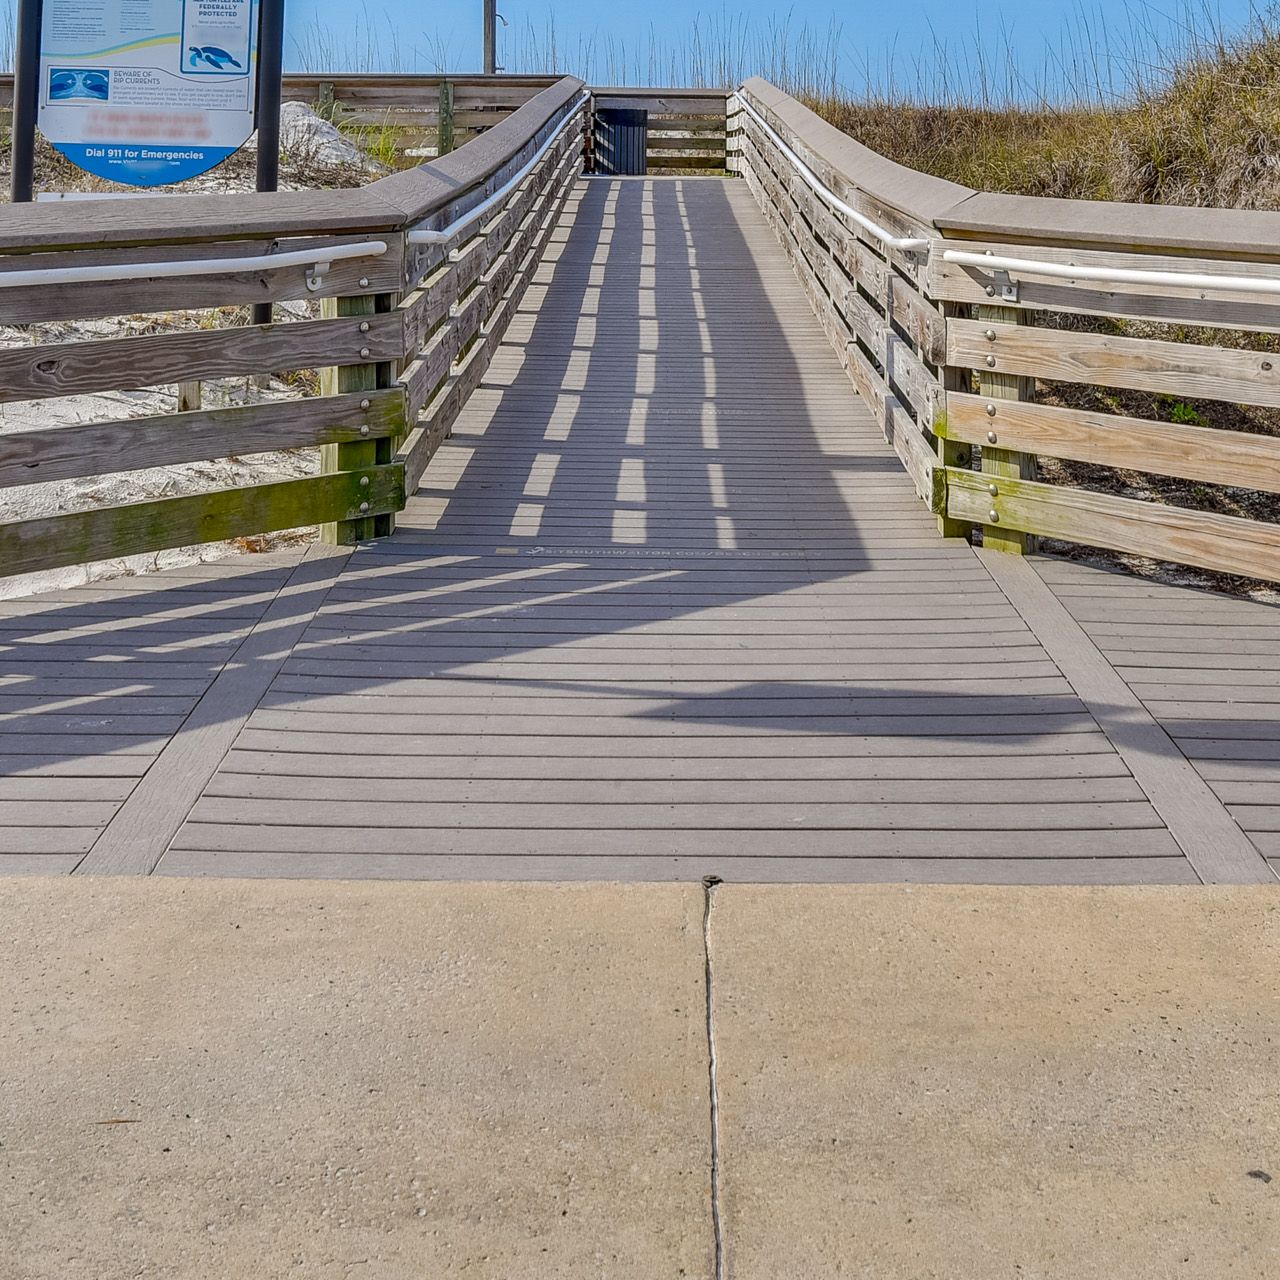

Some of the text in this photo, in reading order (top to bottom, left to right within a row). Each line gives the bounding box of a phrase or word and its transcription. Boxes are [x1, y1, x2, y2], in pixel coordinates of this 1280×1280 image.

[85, 148, 204, 160] Dial 911 for Emergencies
